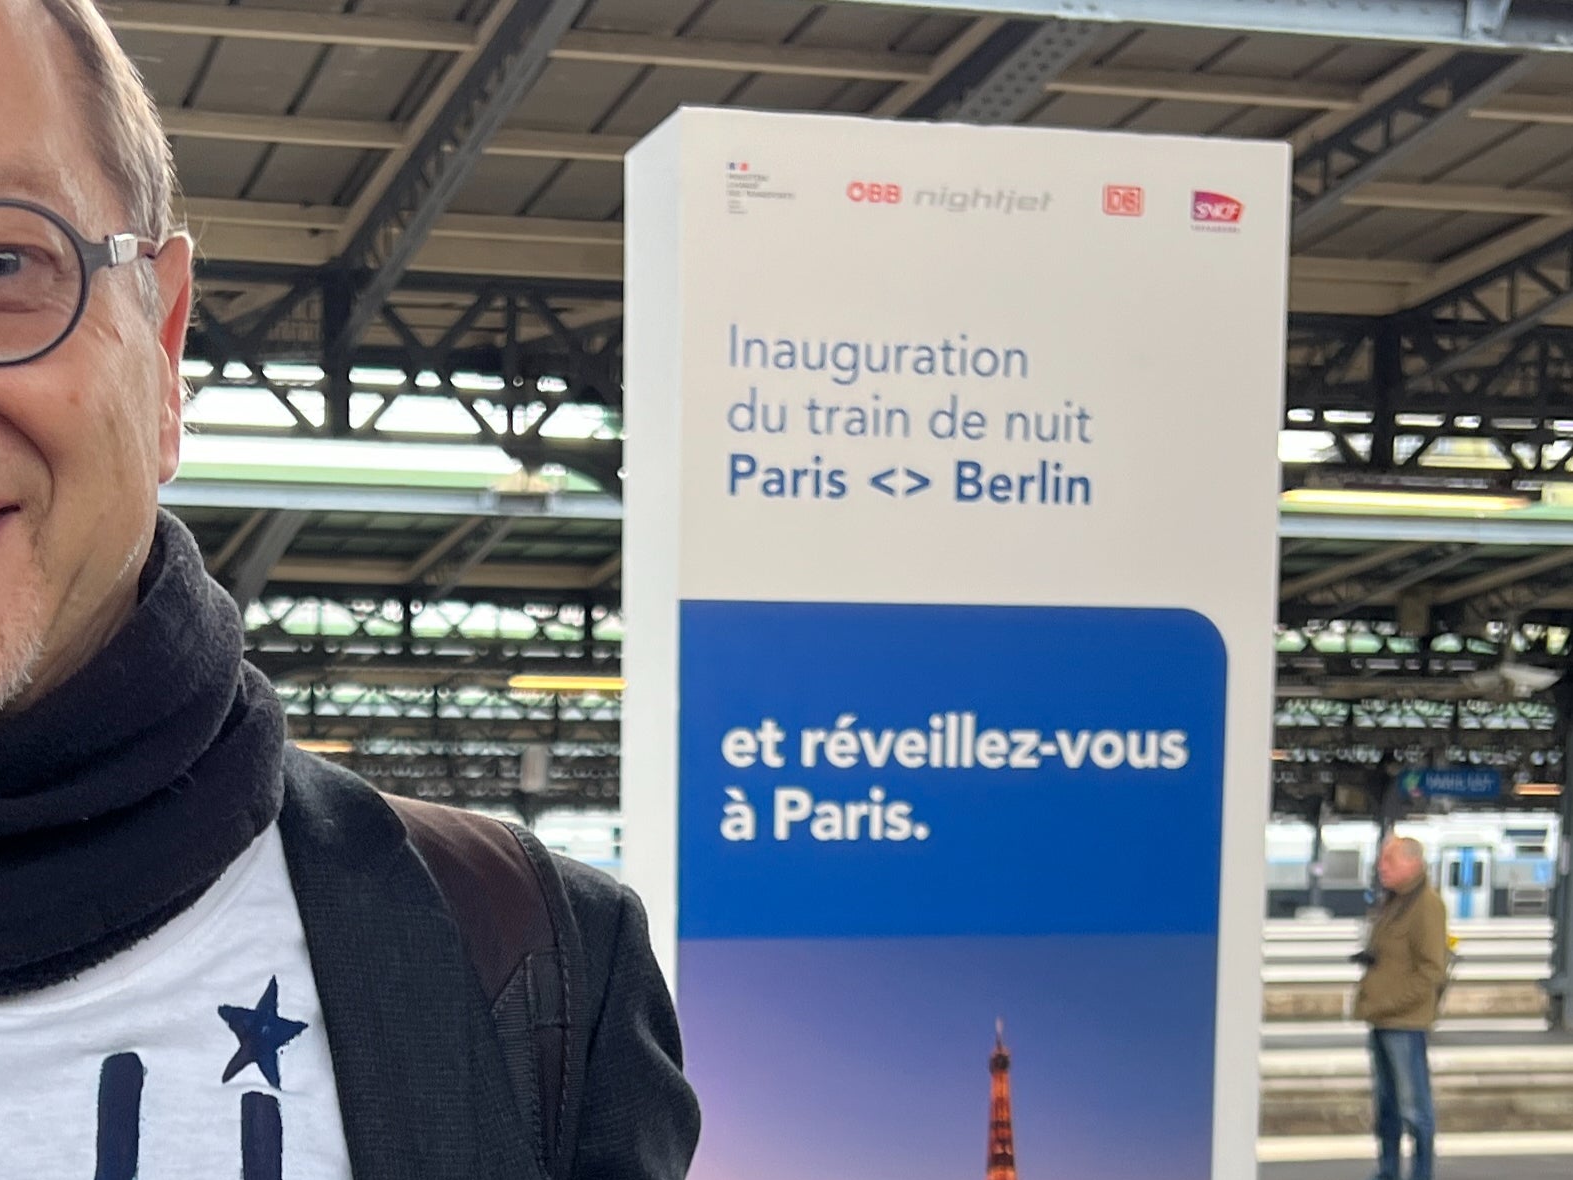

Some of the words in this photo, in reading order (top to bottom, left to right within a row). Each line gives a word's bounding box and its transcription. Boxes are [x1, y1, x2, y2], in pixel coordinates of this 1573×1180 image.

[914, 186, 1052, 215] nightjet
[728, 323, 1028, 386] Inauguration
[726, 386, 788, 434] du
[807, 394, 911, 438] train
[928, 394, 988, 440] de
[1005, 400, 1094, 444] nuit
[728, 453, 848, 500] Paris
[954, 459, 1092, 505] Berlin
[721, 718, 786, 769] et
[799, 711, 1189, 770] réveillez-vous
[720, 786, 756, 842] à
[773, 785, 931, 842] Paris.
